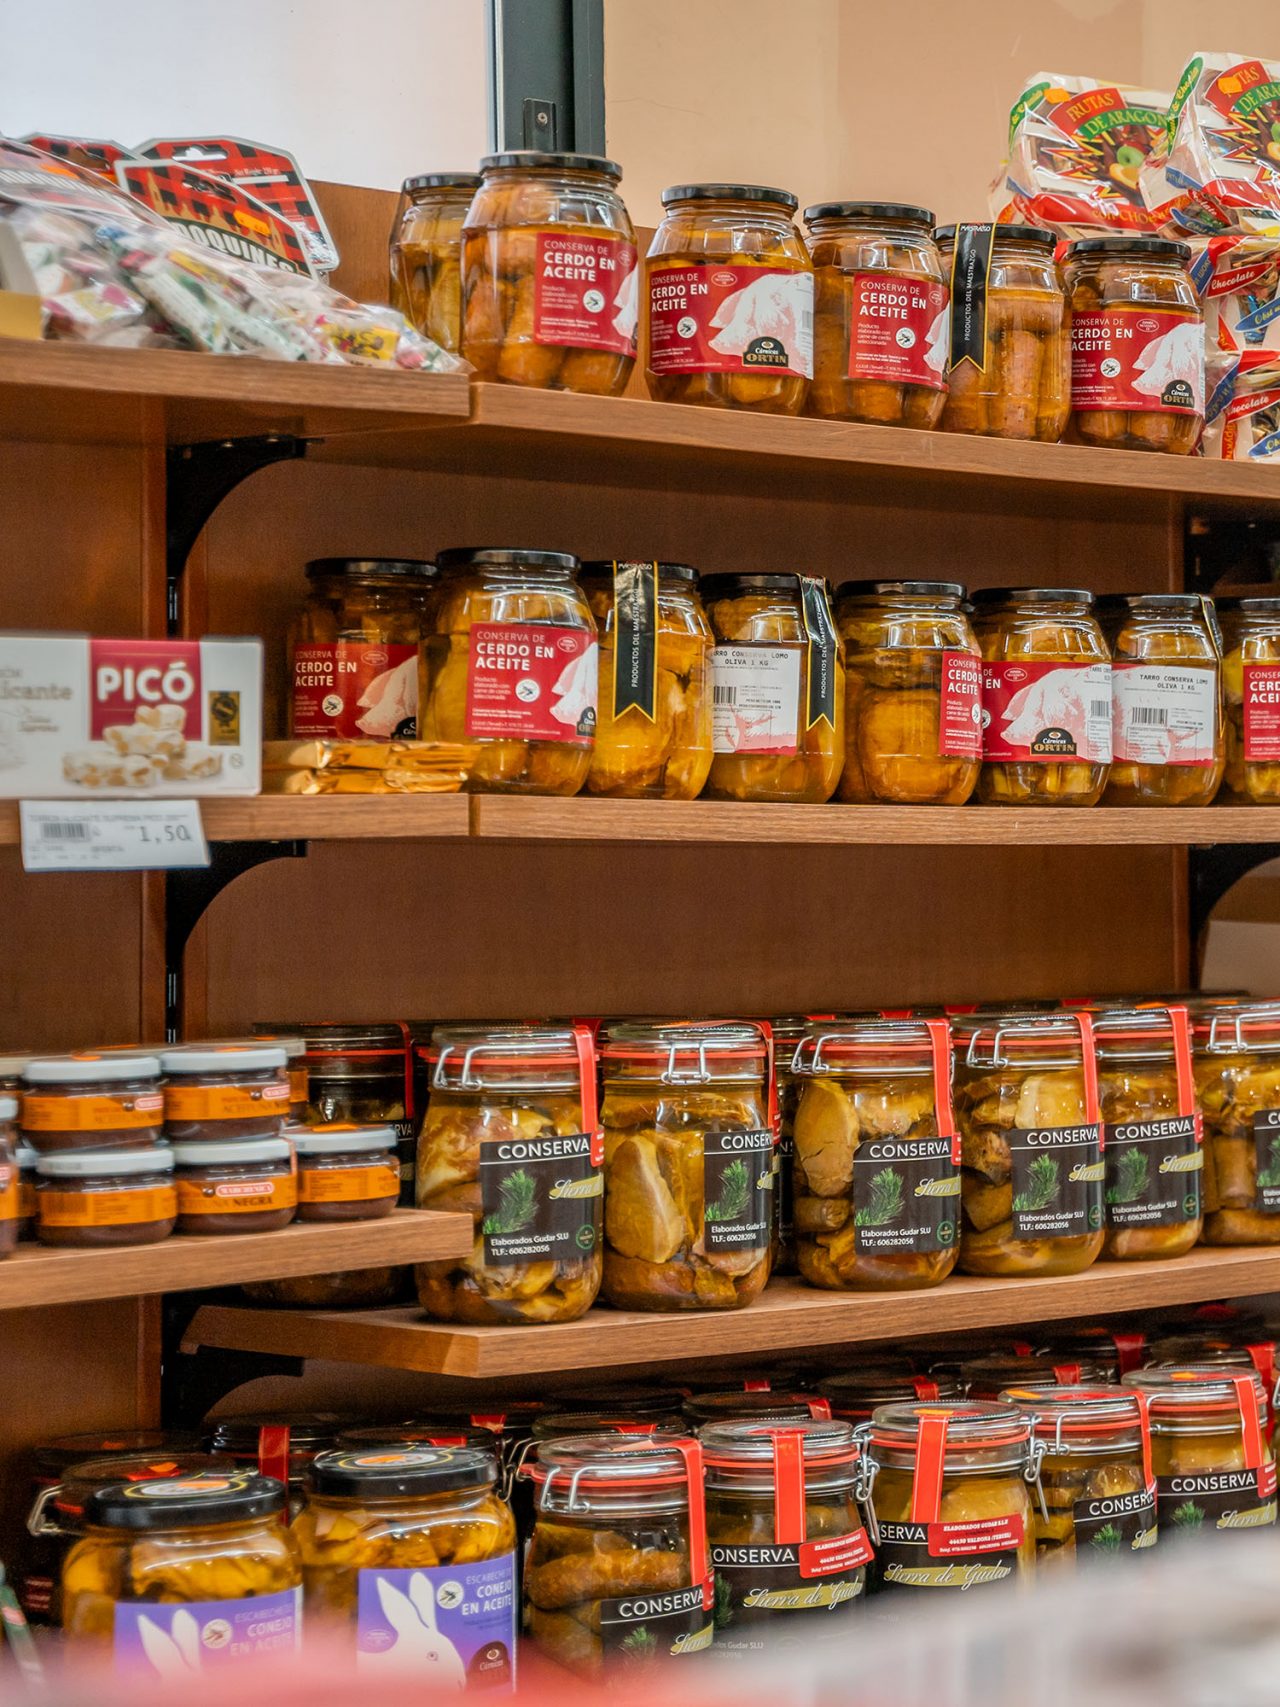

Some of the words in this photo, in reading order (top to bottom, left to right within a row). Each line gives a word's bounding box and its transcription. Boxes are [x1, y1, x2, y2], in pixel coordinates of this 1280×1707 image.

[1066, 93, 1115, 122] FRUTAS
[1239, 94, 1256, 113] DE
[1085, 116, 1105, 136] DE
[544, 240, 595, 253] CONSERVA
[597, 245, 608, 255] DE
[543, 251, 595, 267] CERDO
[599, 258, 615, 271] EN
[966, 248, 977, 288] MAESTRAZGO
[543, 265, 596, 282] ACEITE
[651, 273, 684, 286] CONSERVA
[687, 273, 698, 281] DE
[651, 285, 686, 299] CERDO
[690, 284, 708, 295] EN
[861, 281, 907, 293] CONSERVA
[910, 286, 920, 295] DE
[651, 298, 687, 312] ACEITE
[860, 292, 908, 305] CERDO
[911, 297, 927, 310] EN
[859, 306, 908, 320] ACEITE
[964, 302, 972, 341] PRODUCTOS
[1072, 318, 1109, 326] CONSERVA
[1113, 318, 1124, 326] DE
[1072, 328, 1111, 339] CERDO
[1115, 328, 1133, 339] EN
[1072, 340, 1111, 351] ACEITE
[477, 631, 529, 642] CONSERVA
[532, 634, 545, 643] DE
[632, 633, 640, 646] DEL
[296, 650, 332, 659] CONSERVA
[335, 651, 347, 659] DE
[476, 643, 530, 656] CERDO
[535, 646, 554, 659] EN
[296, 662, 333, 673] CERDO
[338, 662, 357, 673] EN
[475, 657, 530, 671] ACEITE
[631, 647, 640, 688] PRODUCTOS
[97, 661, 195, 702] PICÓ
[296, 676, 334, 687] ACEITE
[948, 669, 978, 683] CERDO
[1164, 675, 1193, 683] CONSERVA
[948, 682, 978, 695] ACEITE
[986, 679, 1001, 689] EN
[0, 683, 73, 701] licante
[1027, 1128, 1098, 1145] CONSERVA
[1115, 1119, 1191, 1140] CONSERVA
[498, 1138, 590, 1159] CONSERVA
[869, 1141, 949, 1158] CONSERVA
[1112, 1205, 1147, 1214] Elaborados
[710, 1225, 745, 1233] Elaborados
[860, 1229, 899, 1238] Elaborados
[899, 1228, 919, 1236] Gudar
[920, 1227, 931, 1235] SLU
[490, 1236, 532, 1246] Elaborados
[533, 1234, 556, 1243] Gudar
[556, 1232, 569, 1241] SLU
[877, 1237, 914, 1246] 606282056
[508, 1244, 550, 1255] 606282056
[1171, 1472, 1255, 1492] CONSERVA
[881, 1524, 926, 1541] SERVA
[713, 1548, 795, 1563] ONSERVA
[884, 1563, 930, 1583] Sierra
[477, 1580, 512, 1598] CONEJO
[619, 1589, 703, 1617] CONSERVA
[743, 1588, 800, 1608] Sierra
[462, 1602, 479, 1616] EN
